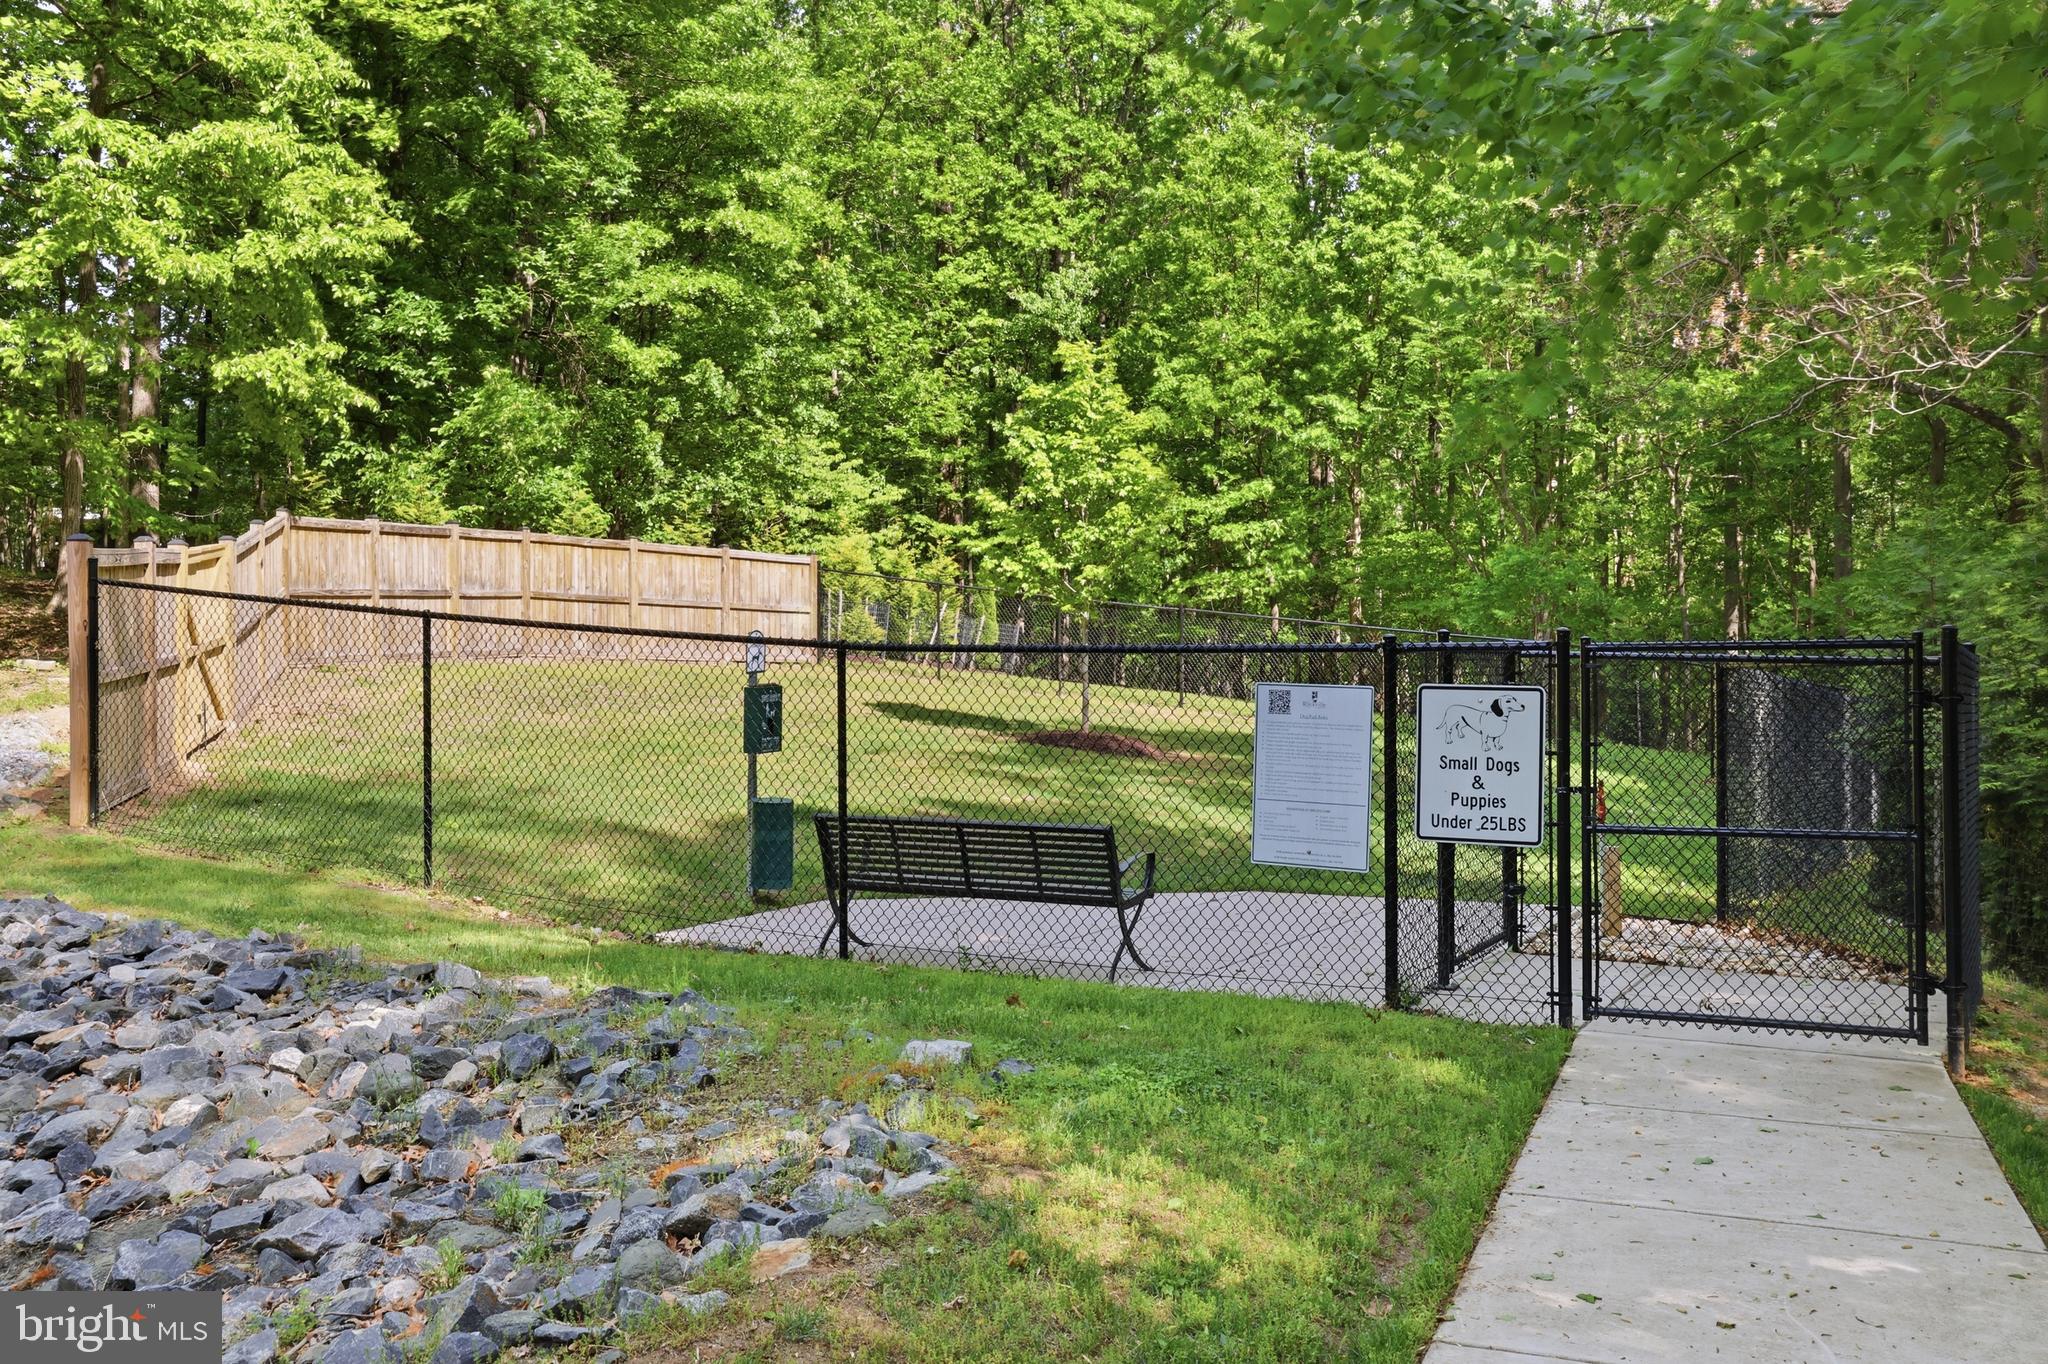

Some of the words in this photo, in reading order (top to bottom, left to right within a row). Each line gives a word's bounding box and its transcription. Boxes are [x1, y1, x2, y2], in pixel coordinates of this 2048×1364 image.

[1439, 755, 1478, 770] Small
[1486, 757, 1520, 776] Dogs
[1471, 775, 1485, 790] &
[1451, 792, 1507, 810] Puppies
[1431, 813, 1472, 829] Under
